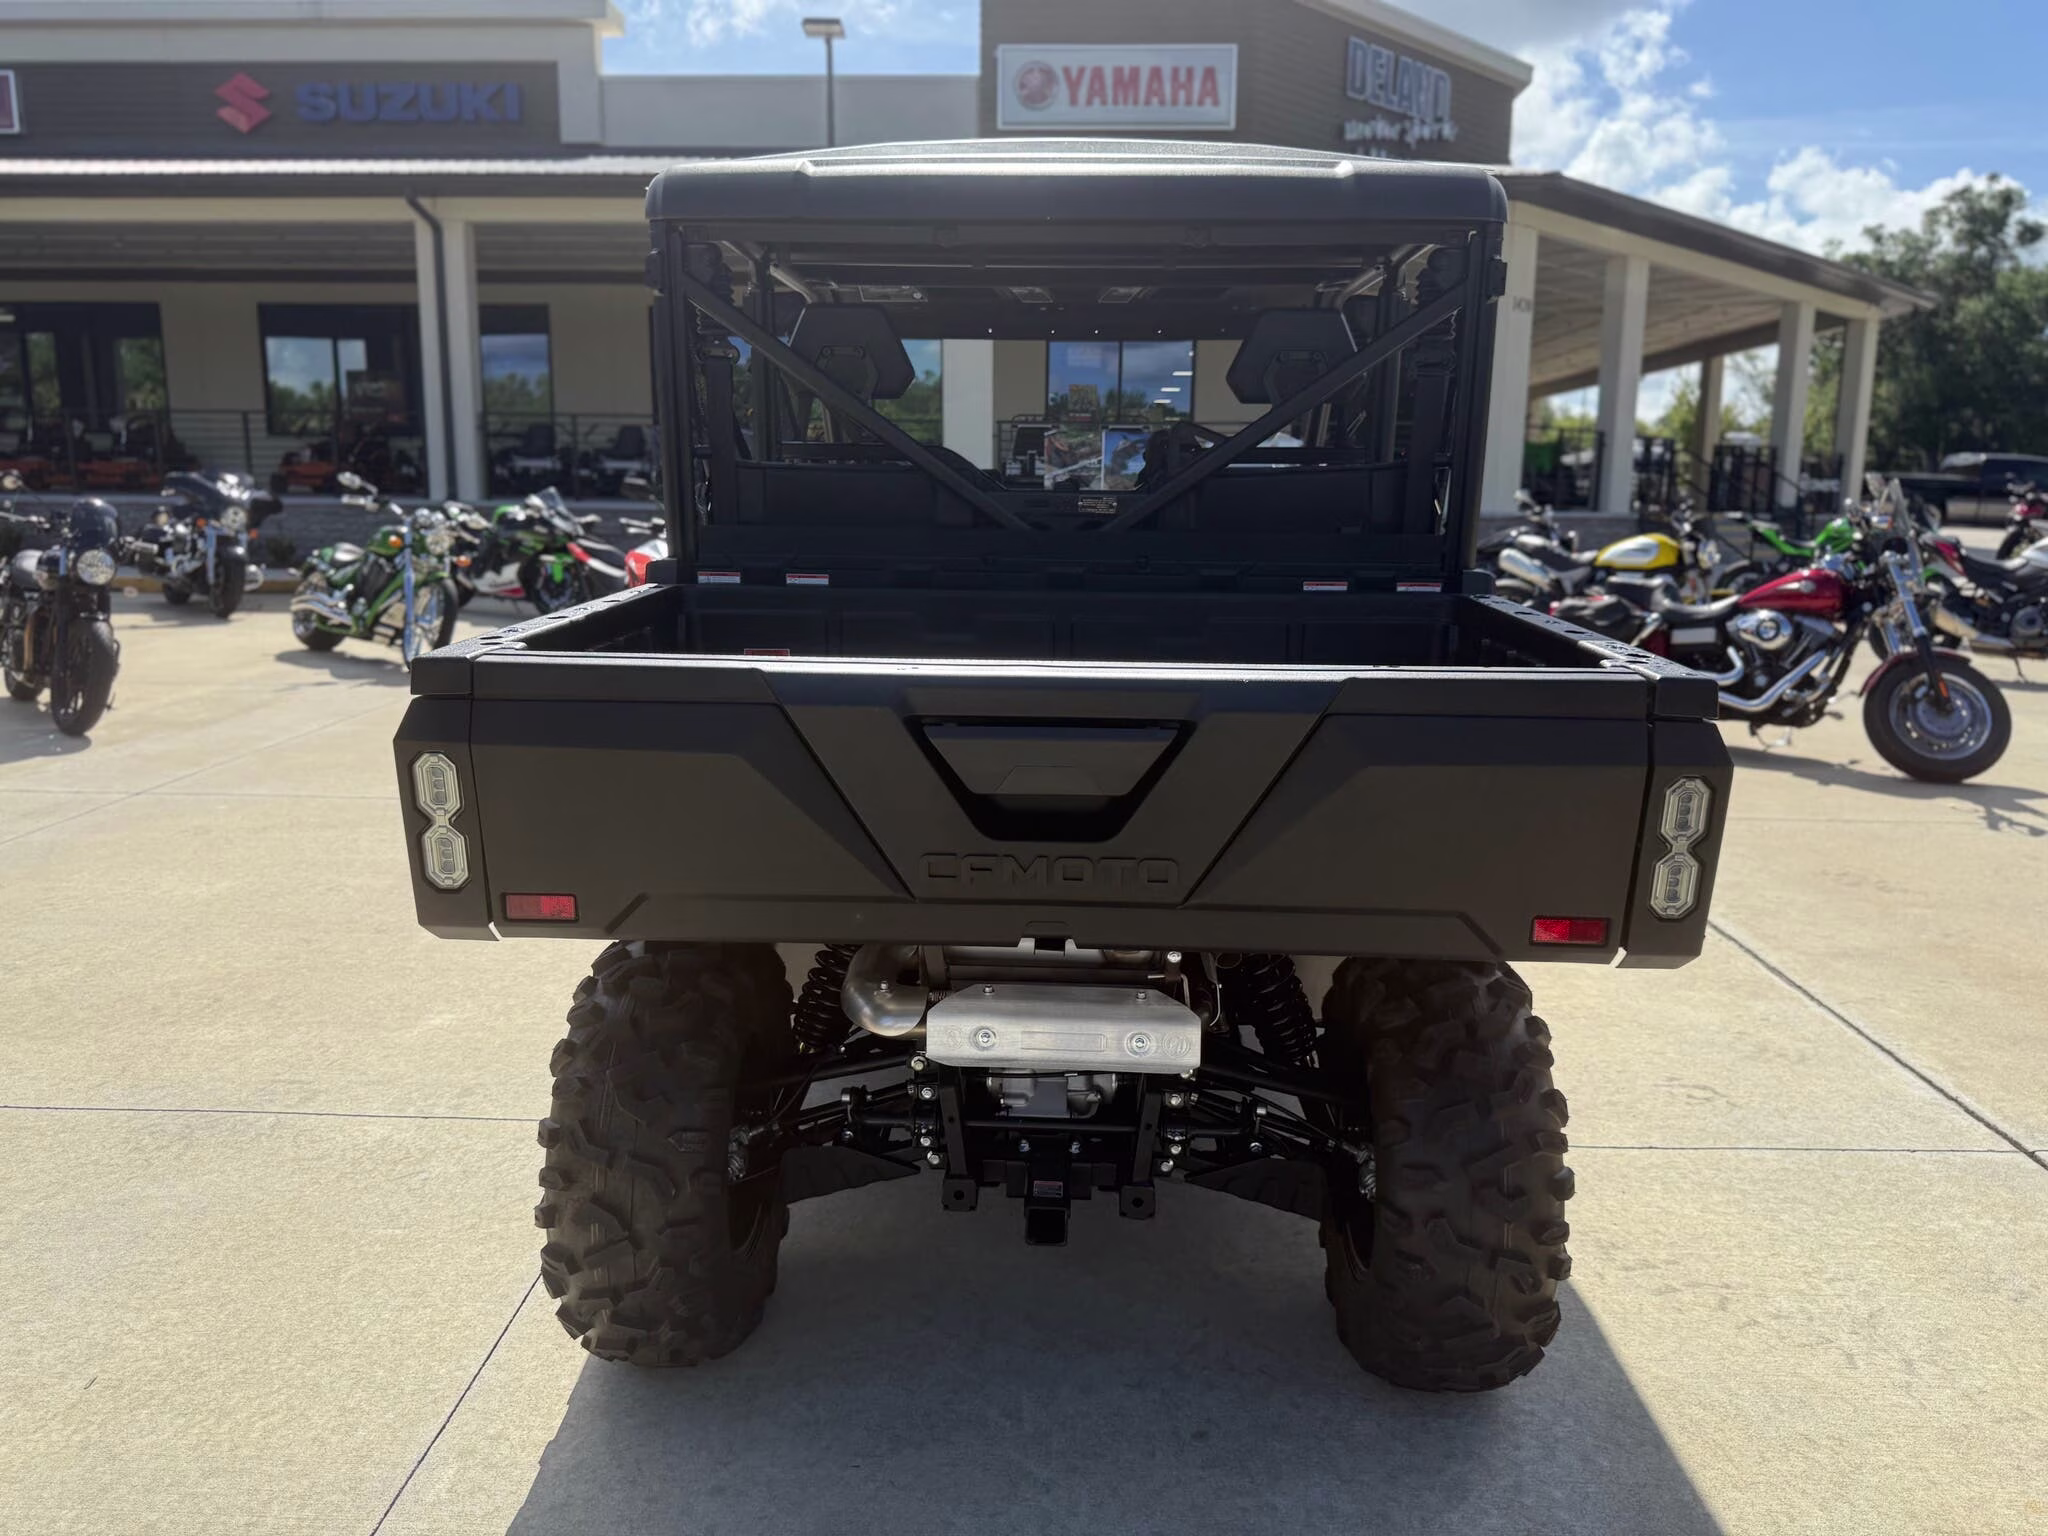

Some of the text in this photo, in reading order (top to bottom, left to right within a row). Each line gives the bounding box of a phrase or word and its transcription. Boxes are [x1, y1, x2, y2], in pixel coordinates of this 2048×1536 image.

[1062, 65, 1221, 108] YAMAHA
[1346, 35, 1452, 122] DELAND
[297, 82, 521, 121] SUZUKI
[919, 853, 1180, 889] CFMOTO
